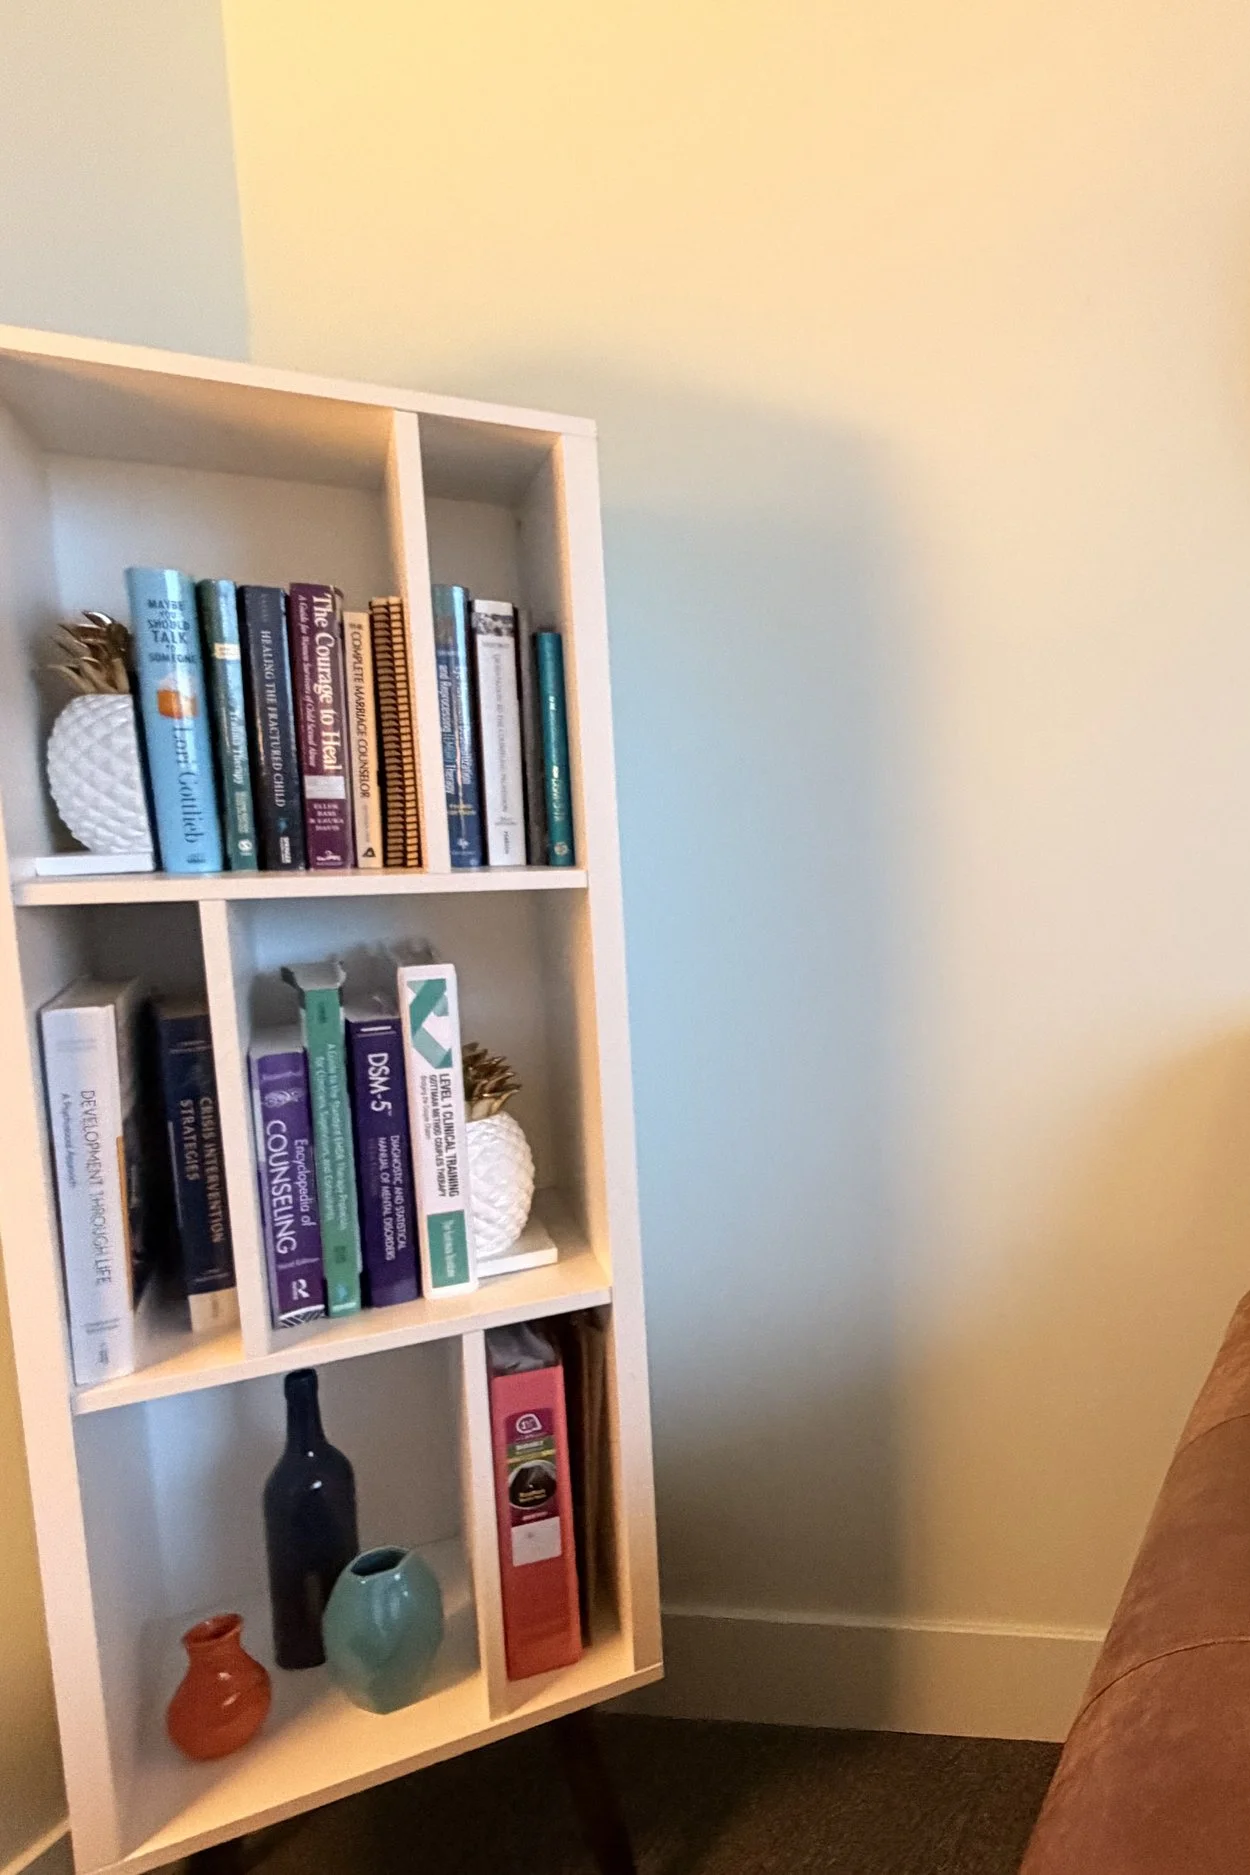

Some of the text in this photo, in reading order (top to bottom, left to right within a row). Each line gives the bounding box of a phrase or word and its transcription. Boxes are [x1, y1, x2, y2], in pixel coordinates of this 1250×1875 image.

[147, 600, 184, 610] MAYBE
[147, 619, 191, 631] SHOULD
[298, 623, 309, 634] for
[299, 602, 309, 623] Guide
[148, 653, 198, 663] SOMEONE
[151, 630, 188, 644] TALK
[260, 631, 275, 679] HEALING
[301, 636, 310, 661] Women
[351, 632, 364, 683] COMPLETE
[264, 683, 277, 703] THE
[302, 662, 313, 694] Survivors
[303, 695, 315, 703] of
[310, 592, 342, 770] The Courage to Heal
[305, 703, 316, 722] Child
[354, 685, 367, 736] MARRIAGE
[437, 681, 454, 732] Reprocessing
[173, 727, 192, 767] Lori
[266, 707, 283, 771] FRACTURED
[308, 746, 318, 767] Abuse
[272, 773, 286, 808] CHILD
[357, 739, 370, 798] COUNSELOR
[443, 765, 458, 794] Therapy
[178, 771, 204, 843] Gottlieb
[62, 1092, 70, 1100] A
[179, 1097, 201, 1183] STRATEGIES
[430, 1074, 446, 1199] GOTTMAN METHOD COUPLES THERAPY
[439, 1073, 459, 1198] LEVEL 1 CLINICAL TRAINING
[80, 1088, 112, 1286] DEVELOPMENT THROUGH LIFE
[199, 1095, 225, 1244] CRISIS INTERVENTION
[266, 1118, 297, 1256] COUNSELING
[292, 1138, 316, 1229] Encyclopedia of
[389, 1134, 407, 1251] DIAGNOSTIC AND STATISTICAL
[376, 1136, 396, 1262] MANUAL OF MENTAL DISORDERS
